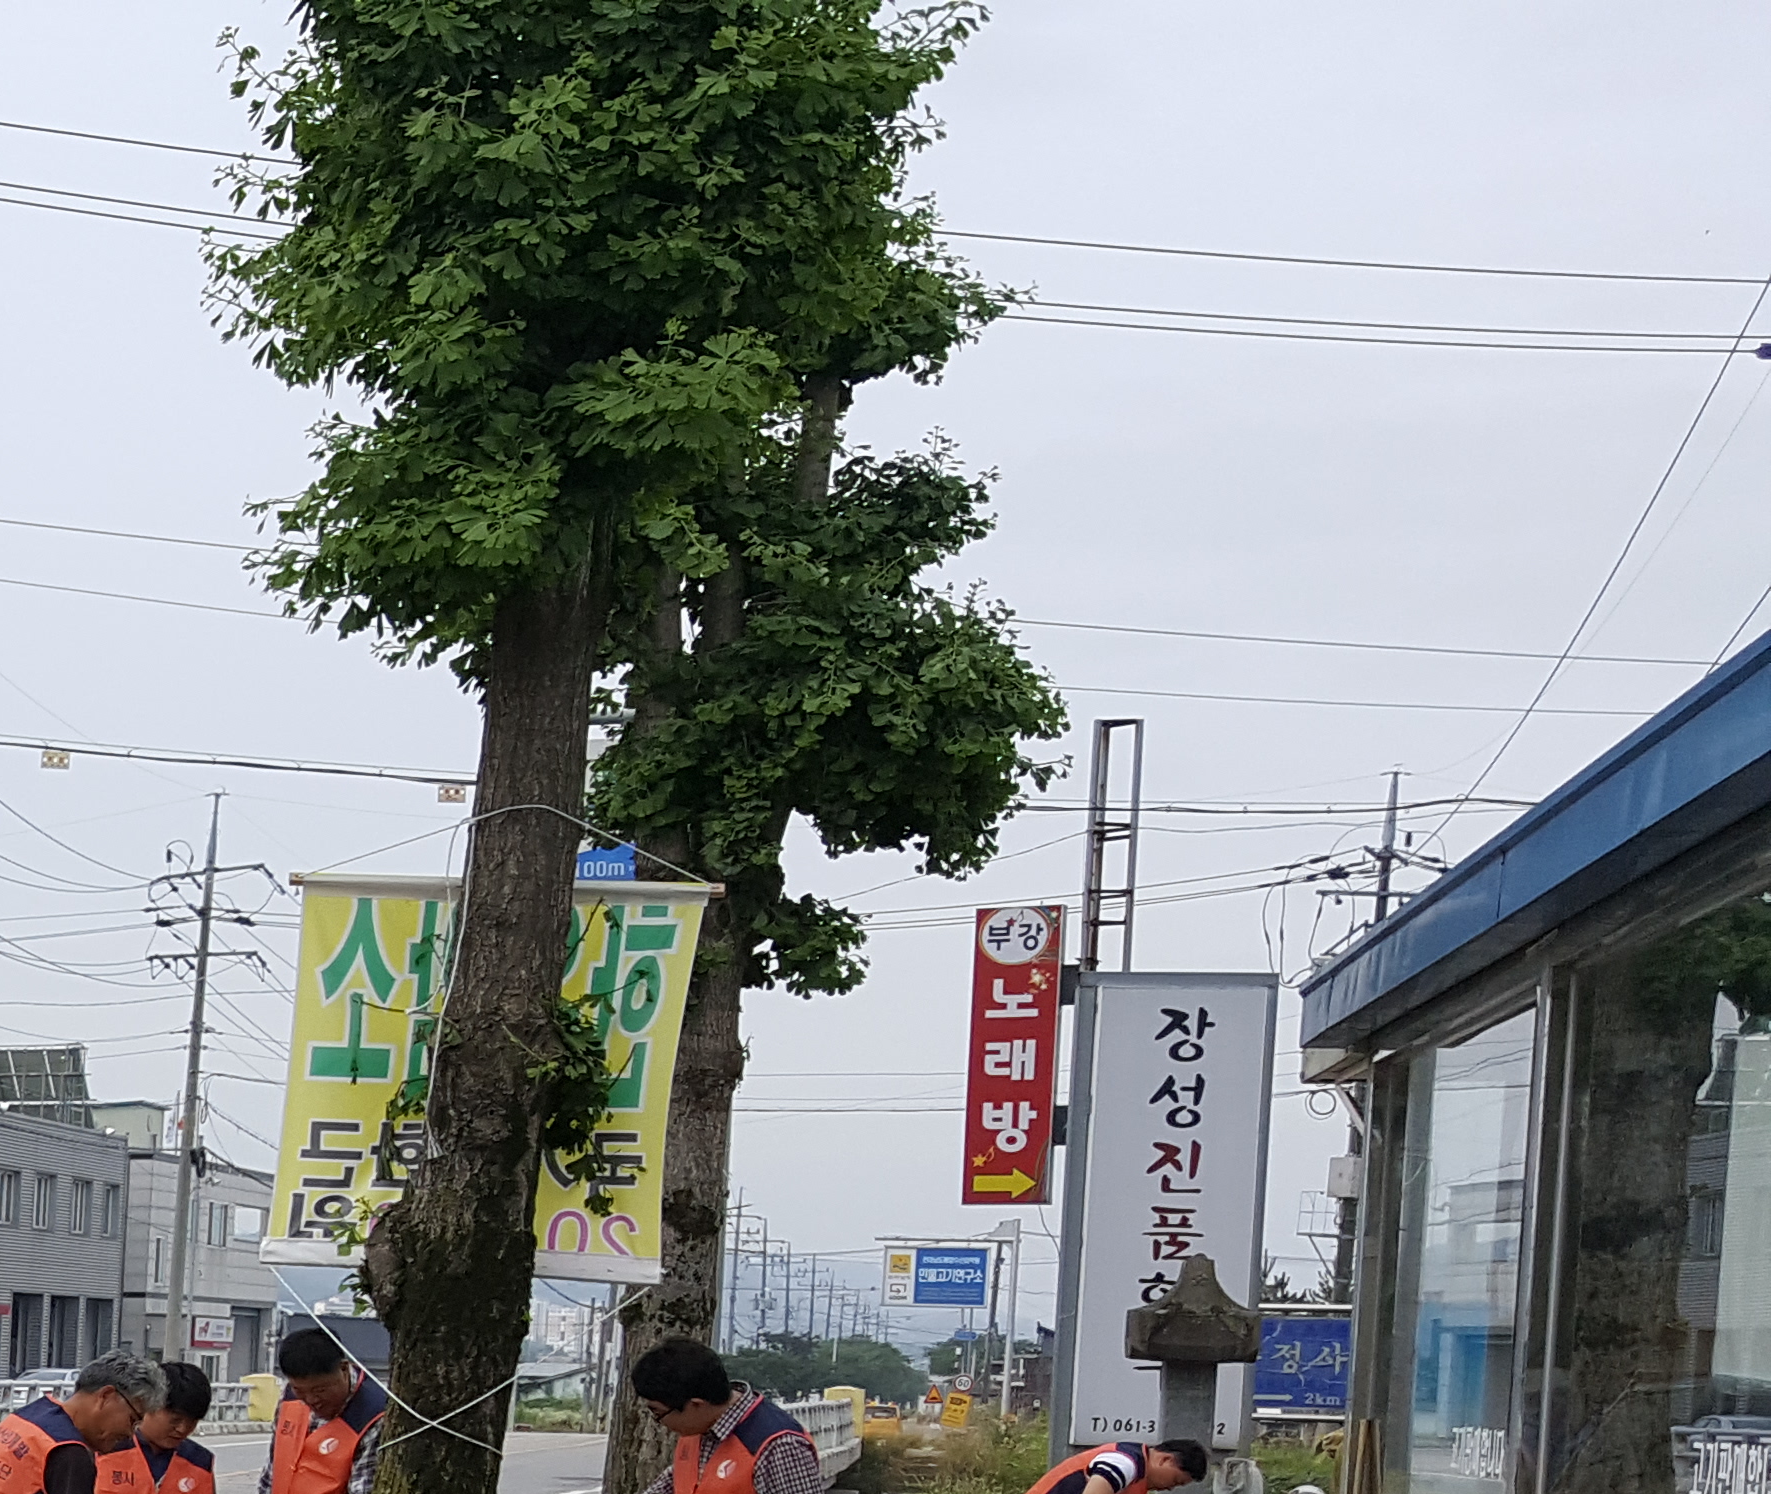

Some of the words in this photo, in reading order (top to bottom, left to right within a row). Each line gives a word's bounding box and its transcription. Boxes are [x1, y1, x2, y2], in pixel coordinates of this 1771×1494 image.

[987, 923, 1044, 951] 부강
[981, 978, 1040, 1154] 노래방
[918, 1268, 984, 1284] 민물고기연구소
[957, 1378, 970, 1388] 60
[1303, 1393, 1341, 1407] 2km
